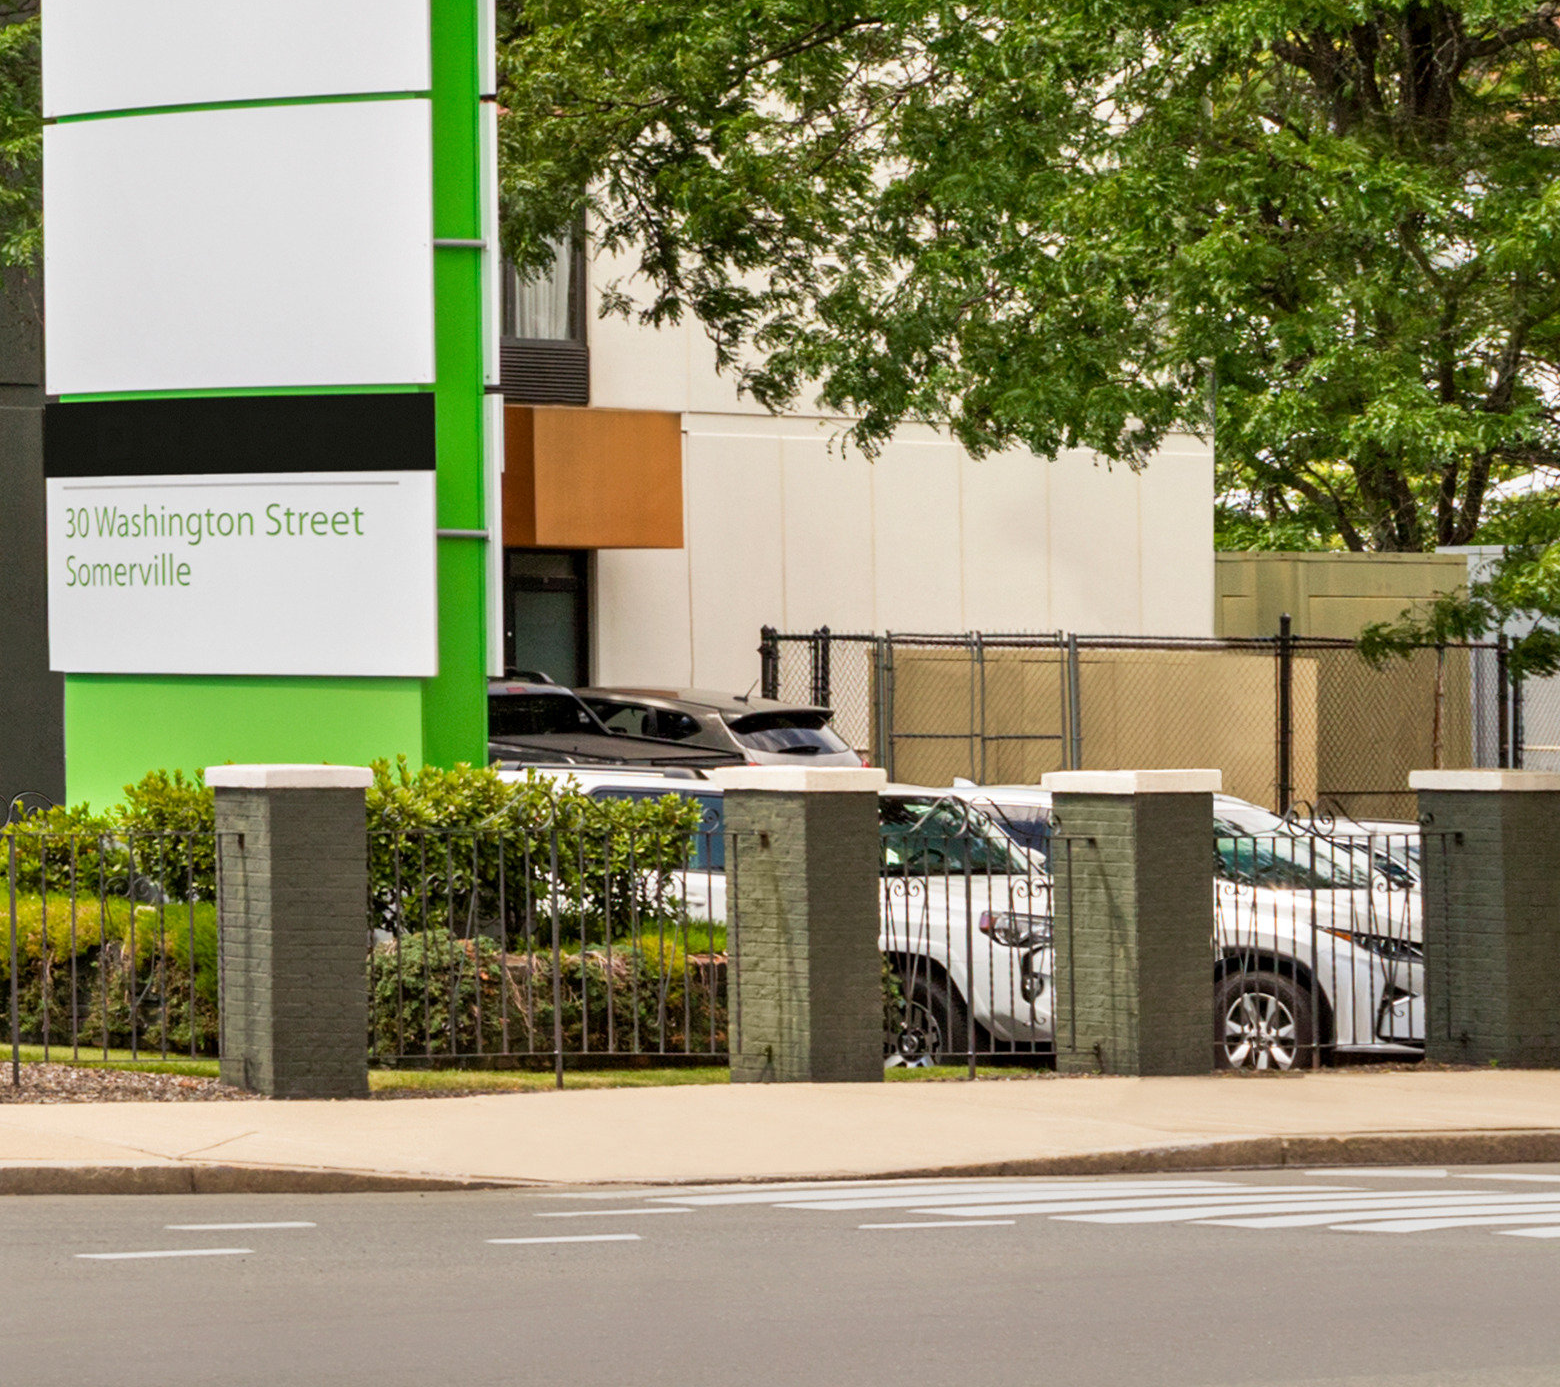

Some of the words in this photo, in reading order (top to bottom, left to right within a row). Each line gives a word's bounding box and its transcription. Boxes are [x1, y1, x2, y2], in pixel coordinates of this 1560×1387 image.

[65, 506, 90, 539] 30
[94, 503, 255, 547] Washington
[265, 502, 365, 537] Street
[65, 552, 192, 588] Somerville
